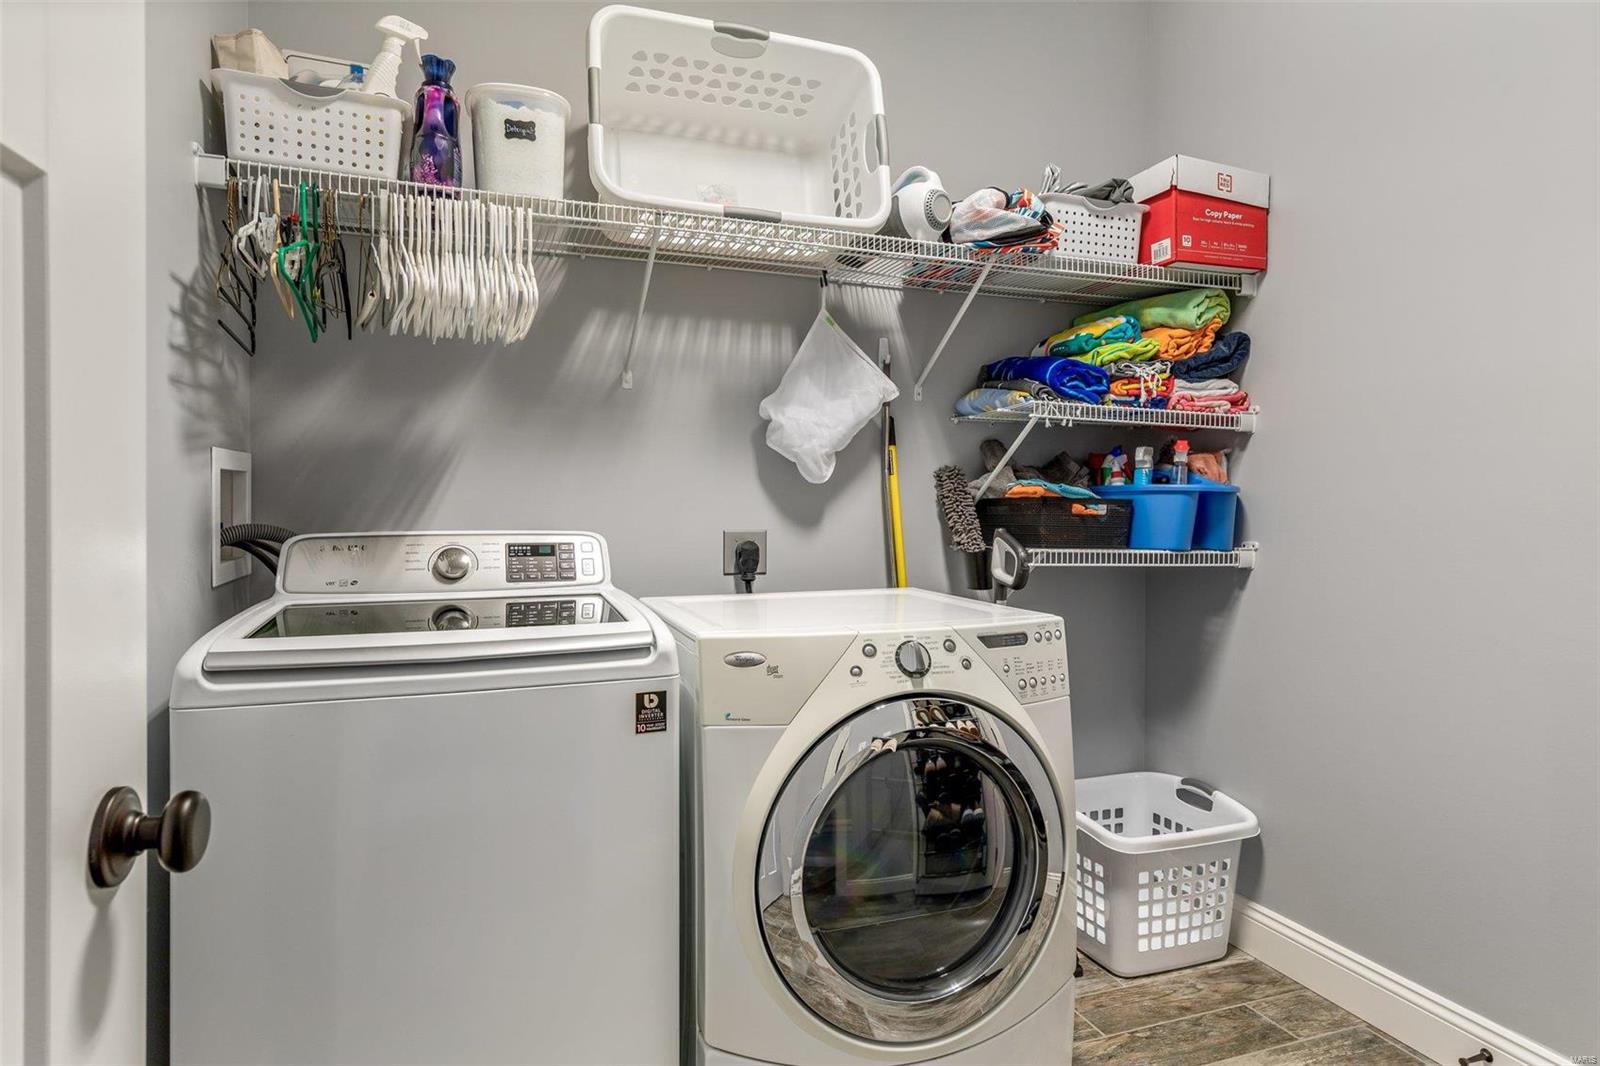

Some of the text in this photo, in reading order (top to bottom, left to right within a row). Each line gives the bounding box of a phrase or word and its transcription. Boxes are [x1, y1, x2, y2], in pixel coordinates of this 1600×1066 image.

[1205, 208, 1243, 220] Copy Paper
[637, 723, 646, 732] 10
